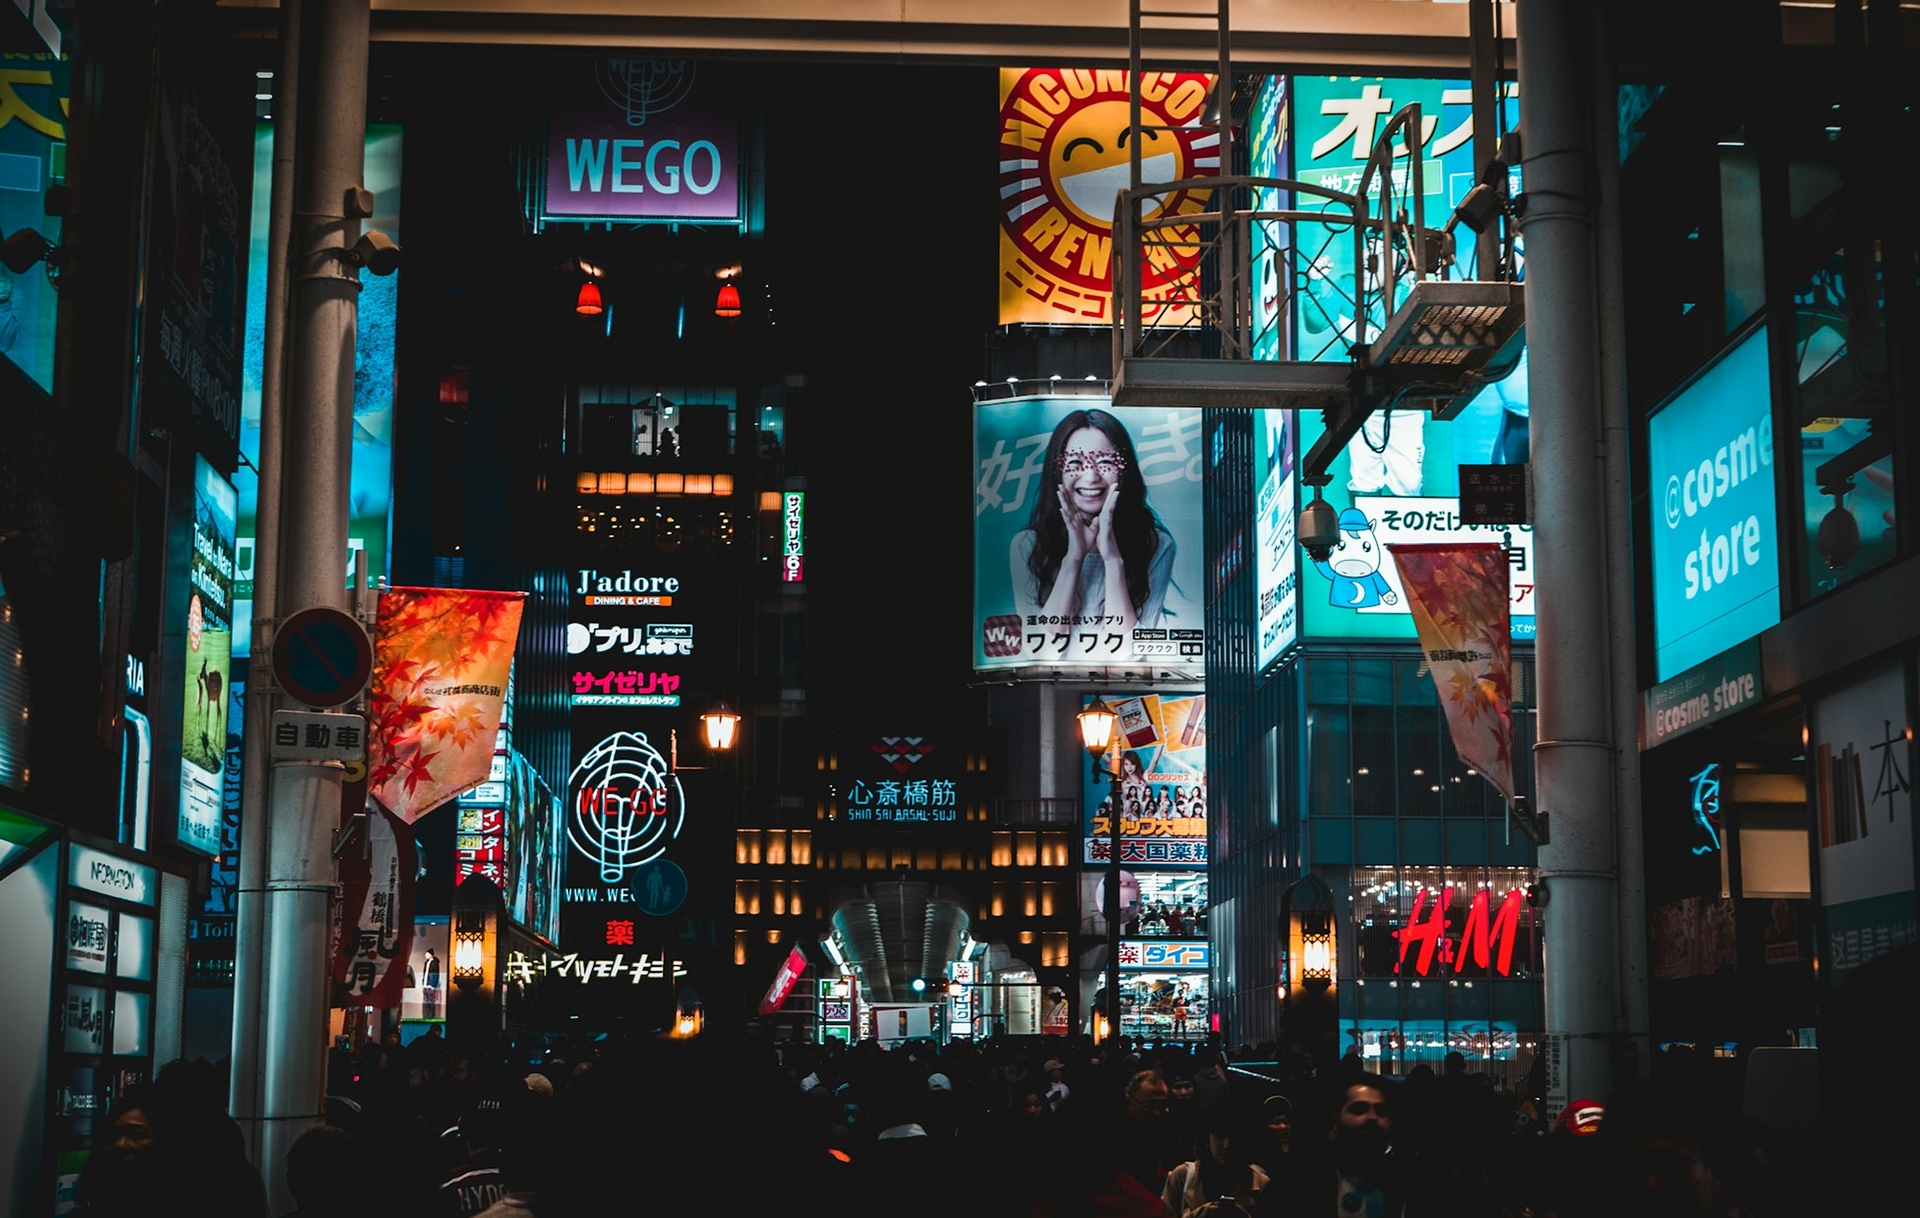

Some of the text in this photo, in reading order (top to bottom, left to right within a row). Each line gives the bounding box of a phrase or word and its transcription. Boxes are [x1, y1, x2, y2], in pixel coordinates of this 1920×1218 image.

[566, 138, 721, 195] WEGO
[1665, 414, 1774, 529] @cosme
[788, 496, 800, 552] サイゼリヤ
[1685, 515, 1760, 600] store
[576, 570, 679, 594] J'adore
[594, 597, 660, 605] DINING & CAFE
[1027, 615, 1124, 626] 運命の出会いアプリ
[1027, 633, 1124, 654] ワクワク
[1138, 645, 1173, 653] ワクワク
[572, 671, 680, 694] サイゼリヤ
[1657, 693, 1709, 737] @cosme
[1714, 673, 1754, 712] store
[276, 722, 360, 750] 自動車
[1870, 720, 1912, 823] 本
[848, 779, 956, 806] 心斎橋筋
[606, 919, 635, 946] 薬
[1391, 888, 1522, 977] H&M
